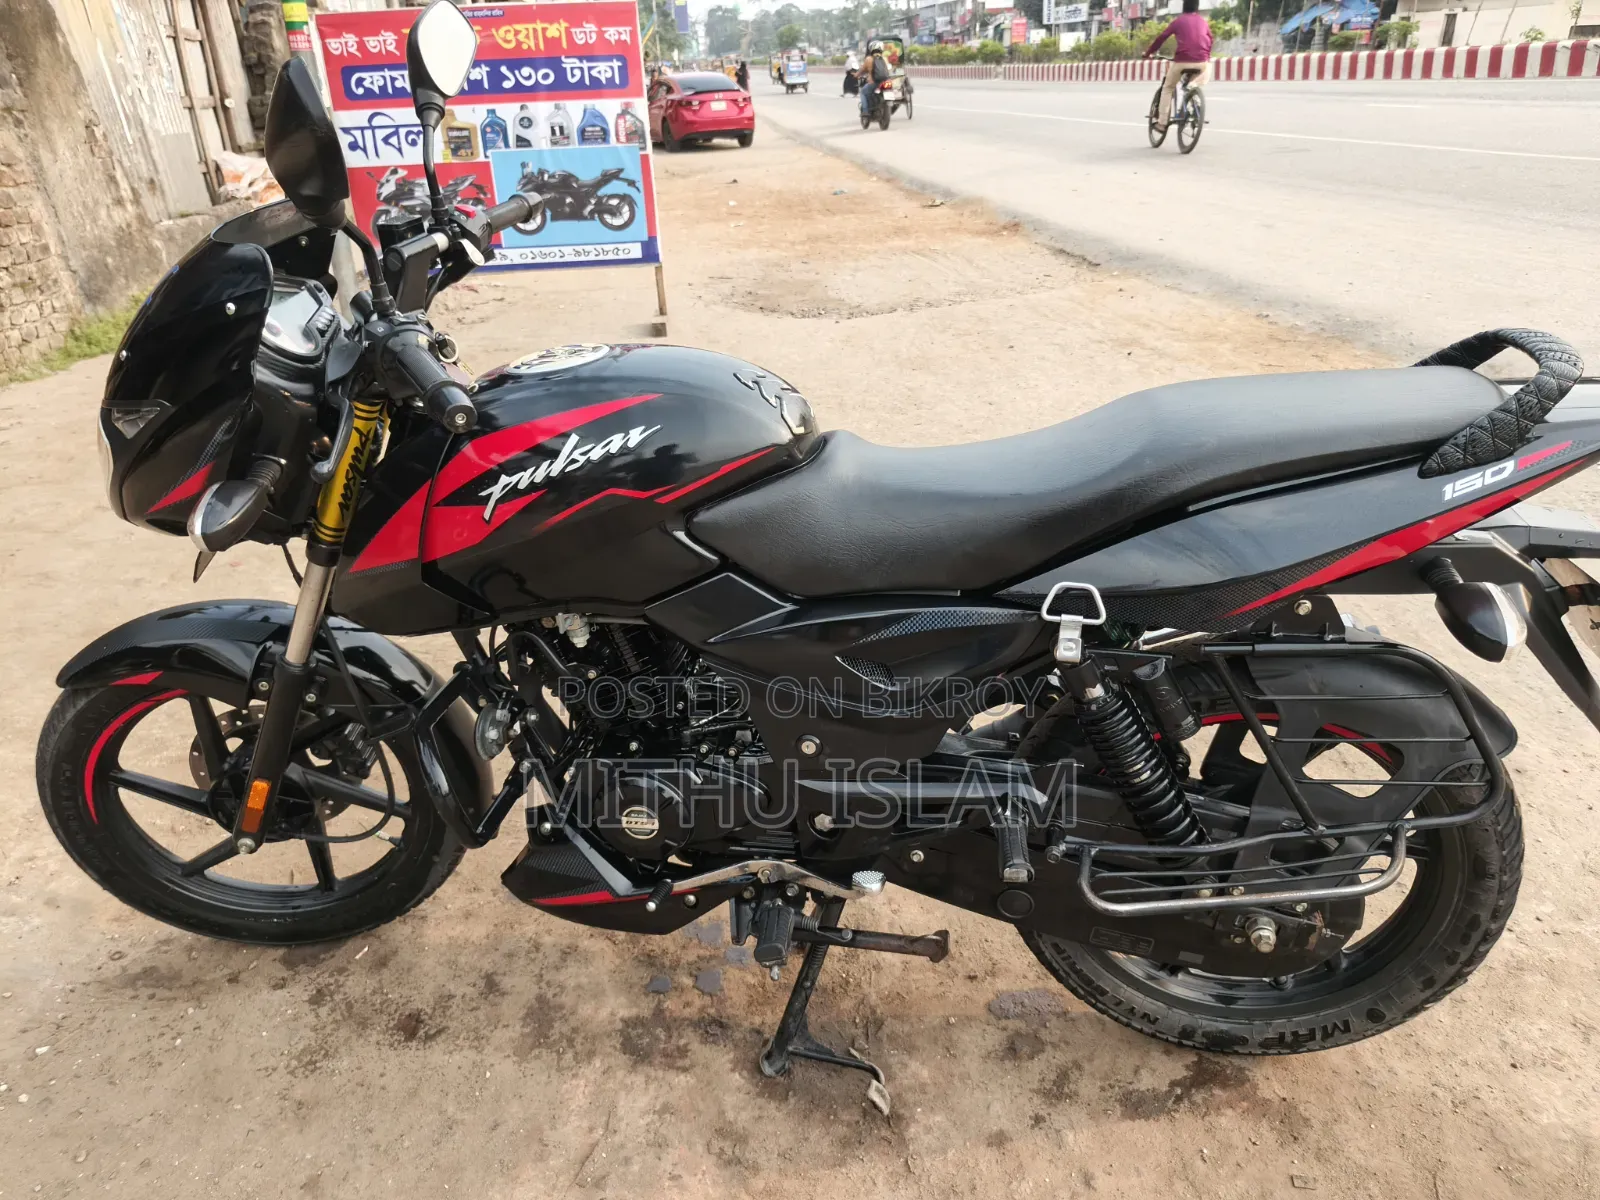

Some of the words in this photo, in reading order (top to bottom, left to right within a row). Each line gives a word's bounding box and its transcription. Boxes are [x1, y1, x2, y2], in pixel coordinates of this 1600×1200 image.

[325, 32, 362, 59] ভাই
[363, 29, 400, 57] ভাই
[491, 18, 571, 52] ওয়াশ
[571, 21, 598, 45] ডট
[601, 26, 632, 46] কম
[500, 65, 555, 89] ১৩০
[561, 55, 622, 86] টাকা
[1441, 460, 1515, 501] 150
